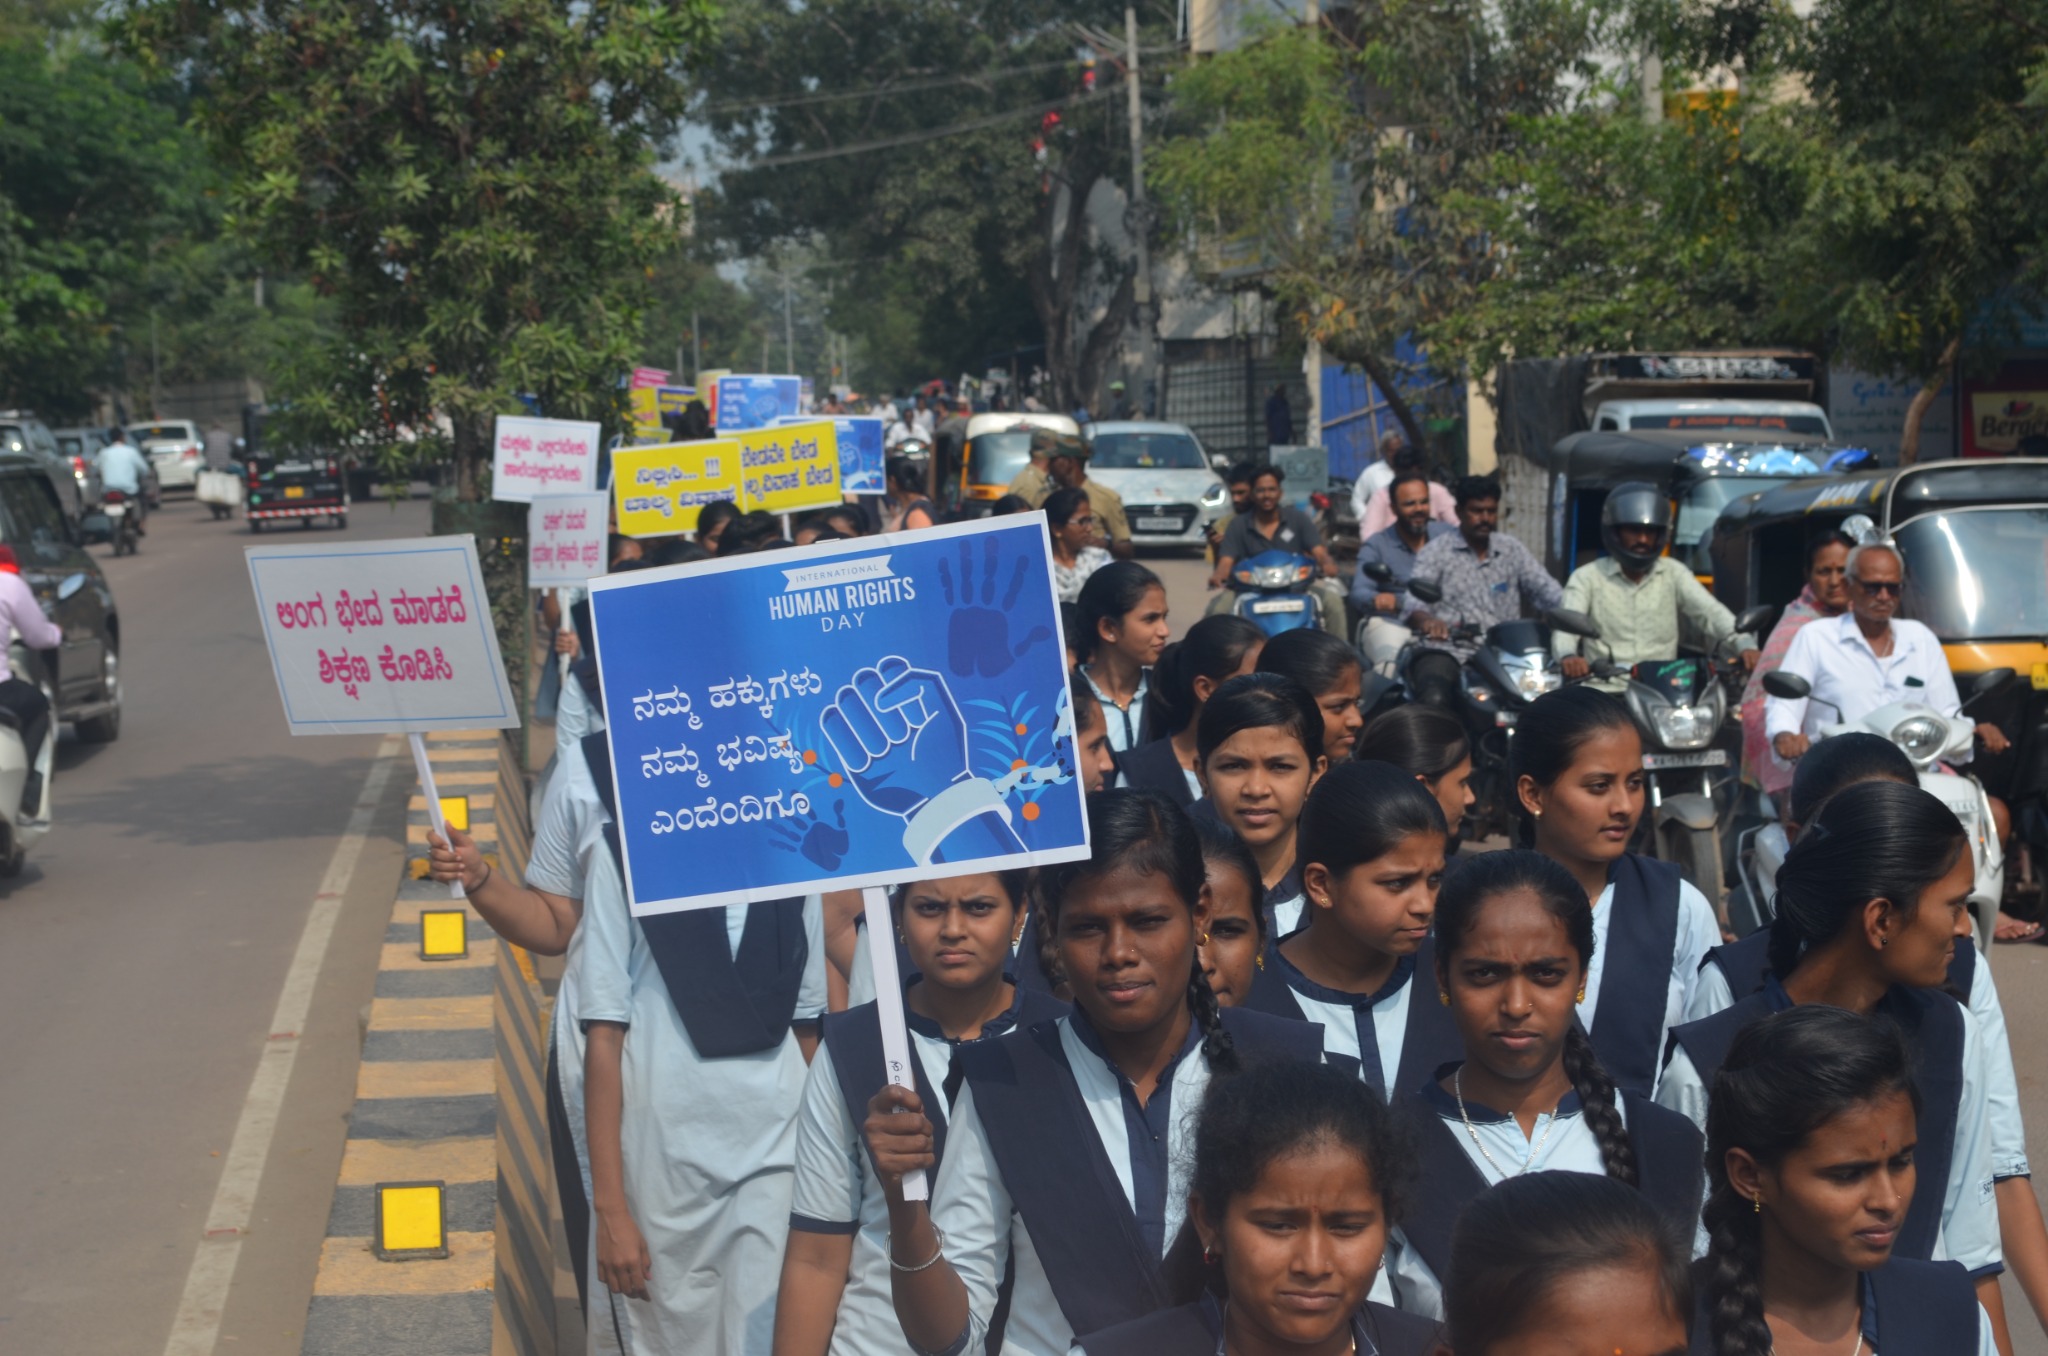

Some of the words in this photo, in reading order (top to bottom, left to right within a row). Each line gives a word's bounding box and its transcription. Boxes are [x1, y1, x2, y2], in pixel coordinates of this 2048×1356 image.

[791, 437, 818, 461] ಬೇಡ
[806, 463, 833, 486] ಬೇಡ
[624, 493, 672, 517] ಬಾಲ್ಯ
[795, 564, 880, 583] INTERNATIONAL
[276, 591, 327, 629] ಲಿಂಗ
[335, 588, 384, 633] ಭೇದ
[390, 584, 467, 626] ಮಾಡದೆ
[768, 587, 840, 620] HUMAN
[844, 576, 916, 609] RIGHTS
[821, 612, 865, 633] DAY
[317, 647, 371, 700] ಶಿಕ್ಷಣ
[378, 645, 453, 682] ಕೊಡಿಸಿ
[632, 685, 703, 731] ನಮ್ಮ
[709, 665, 823, 719] ಹಕ್ಕುಗಳು
[640, 743, 711, 788] ನಮ್ಮ
[717, 727, 805, 775] ಭವಿಷ್ಯ
[650, 787, 811, 835] ಎಂದೆಂದಿಗೂ
